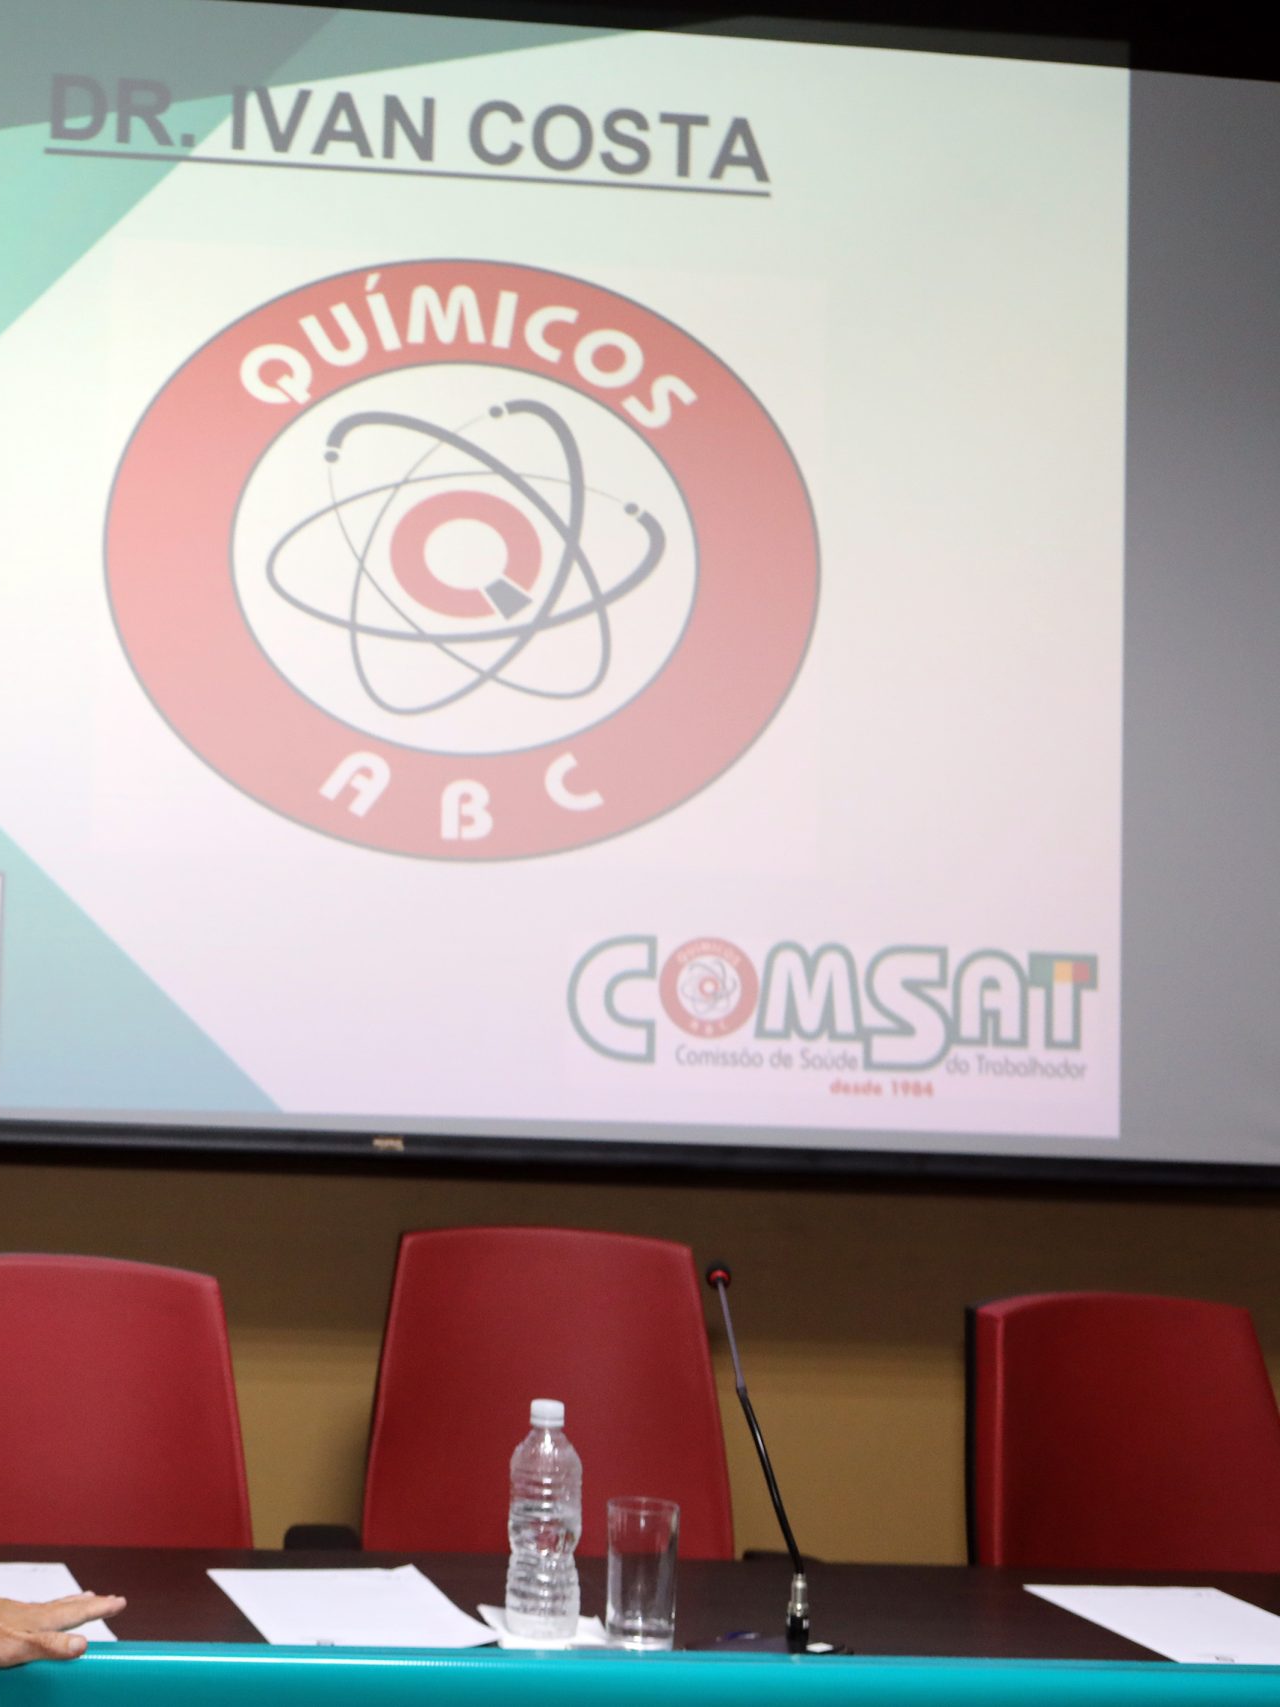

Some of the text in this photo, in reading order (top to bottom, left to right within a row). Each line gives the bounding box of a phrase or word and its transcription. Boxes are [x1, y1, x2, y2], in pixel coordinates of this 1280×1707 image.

[48, 73, 771, 183] DR. IVAN COSTA
[239, 273, 698, 430] QUÍMICOS
[566, 934, 1099, 1071] COMSAT
[769, 1048, 793, 1069] de
[800, 1047, 858, 1070] Saúde
[975, 1054, 1088, 1079] Trabalhador
[830, 1077, 883, 1095] desde
